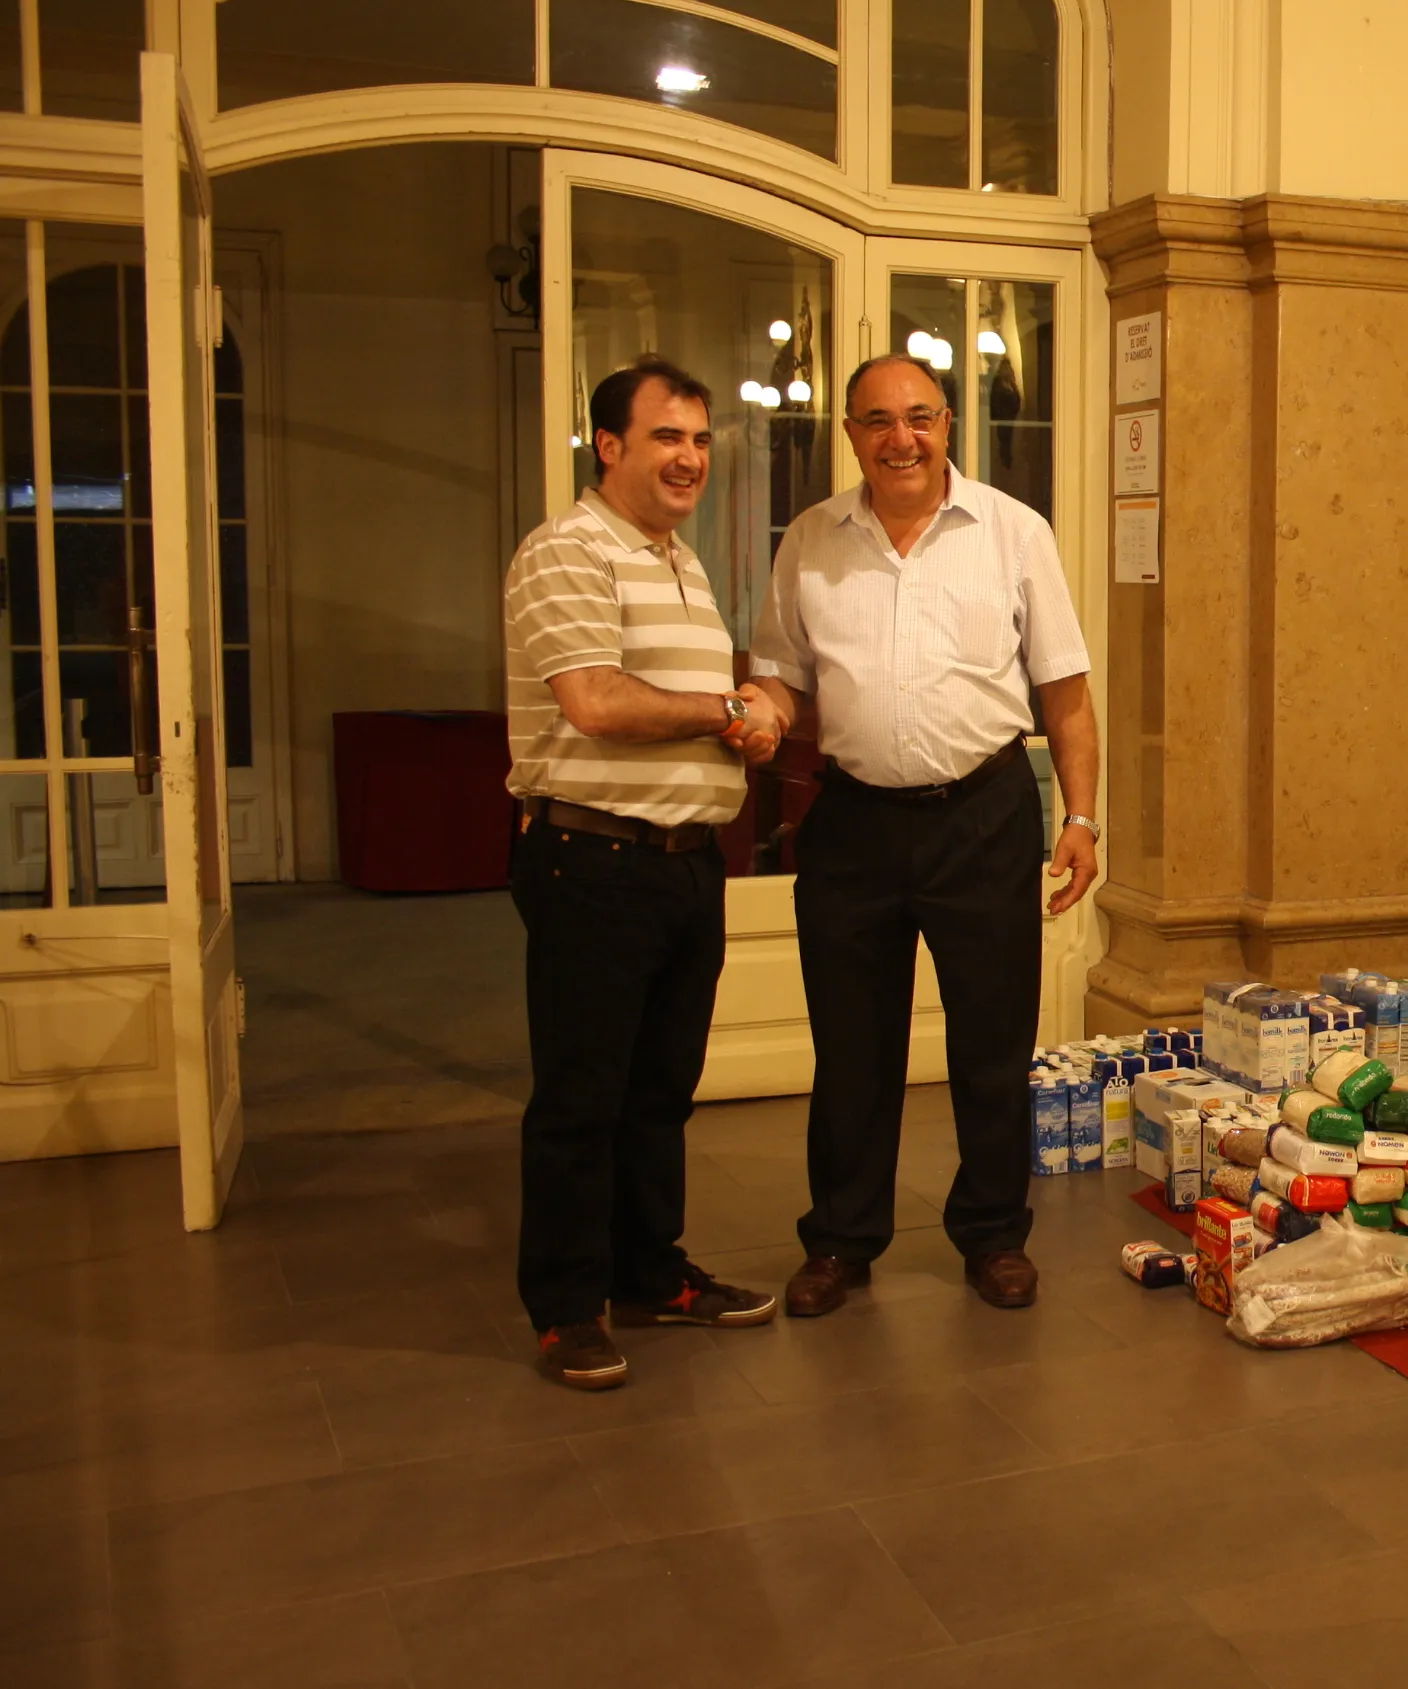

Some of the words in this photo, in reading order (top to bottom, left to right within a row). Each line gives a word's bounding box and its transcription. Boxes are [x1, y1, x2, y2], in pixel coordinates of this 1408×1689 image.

[1106, 1076, 1129, 1089] ATO
[1326, 1112, 1352, 1121] redondo
[1197, 1211, 1227, 1240] brillante
